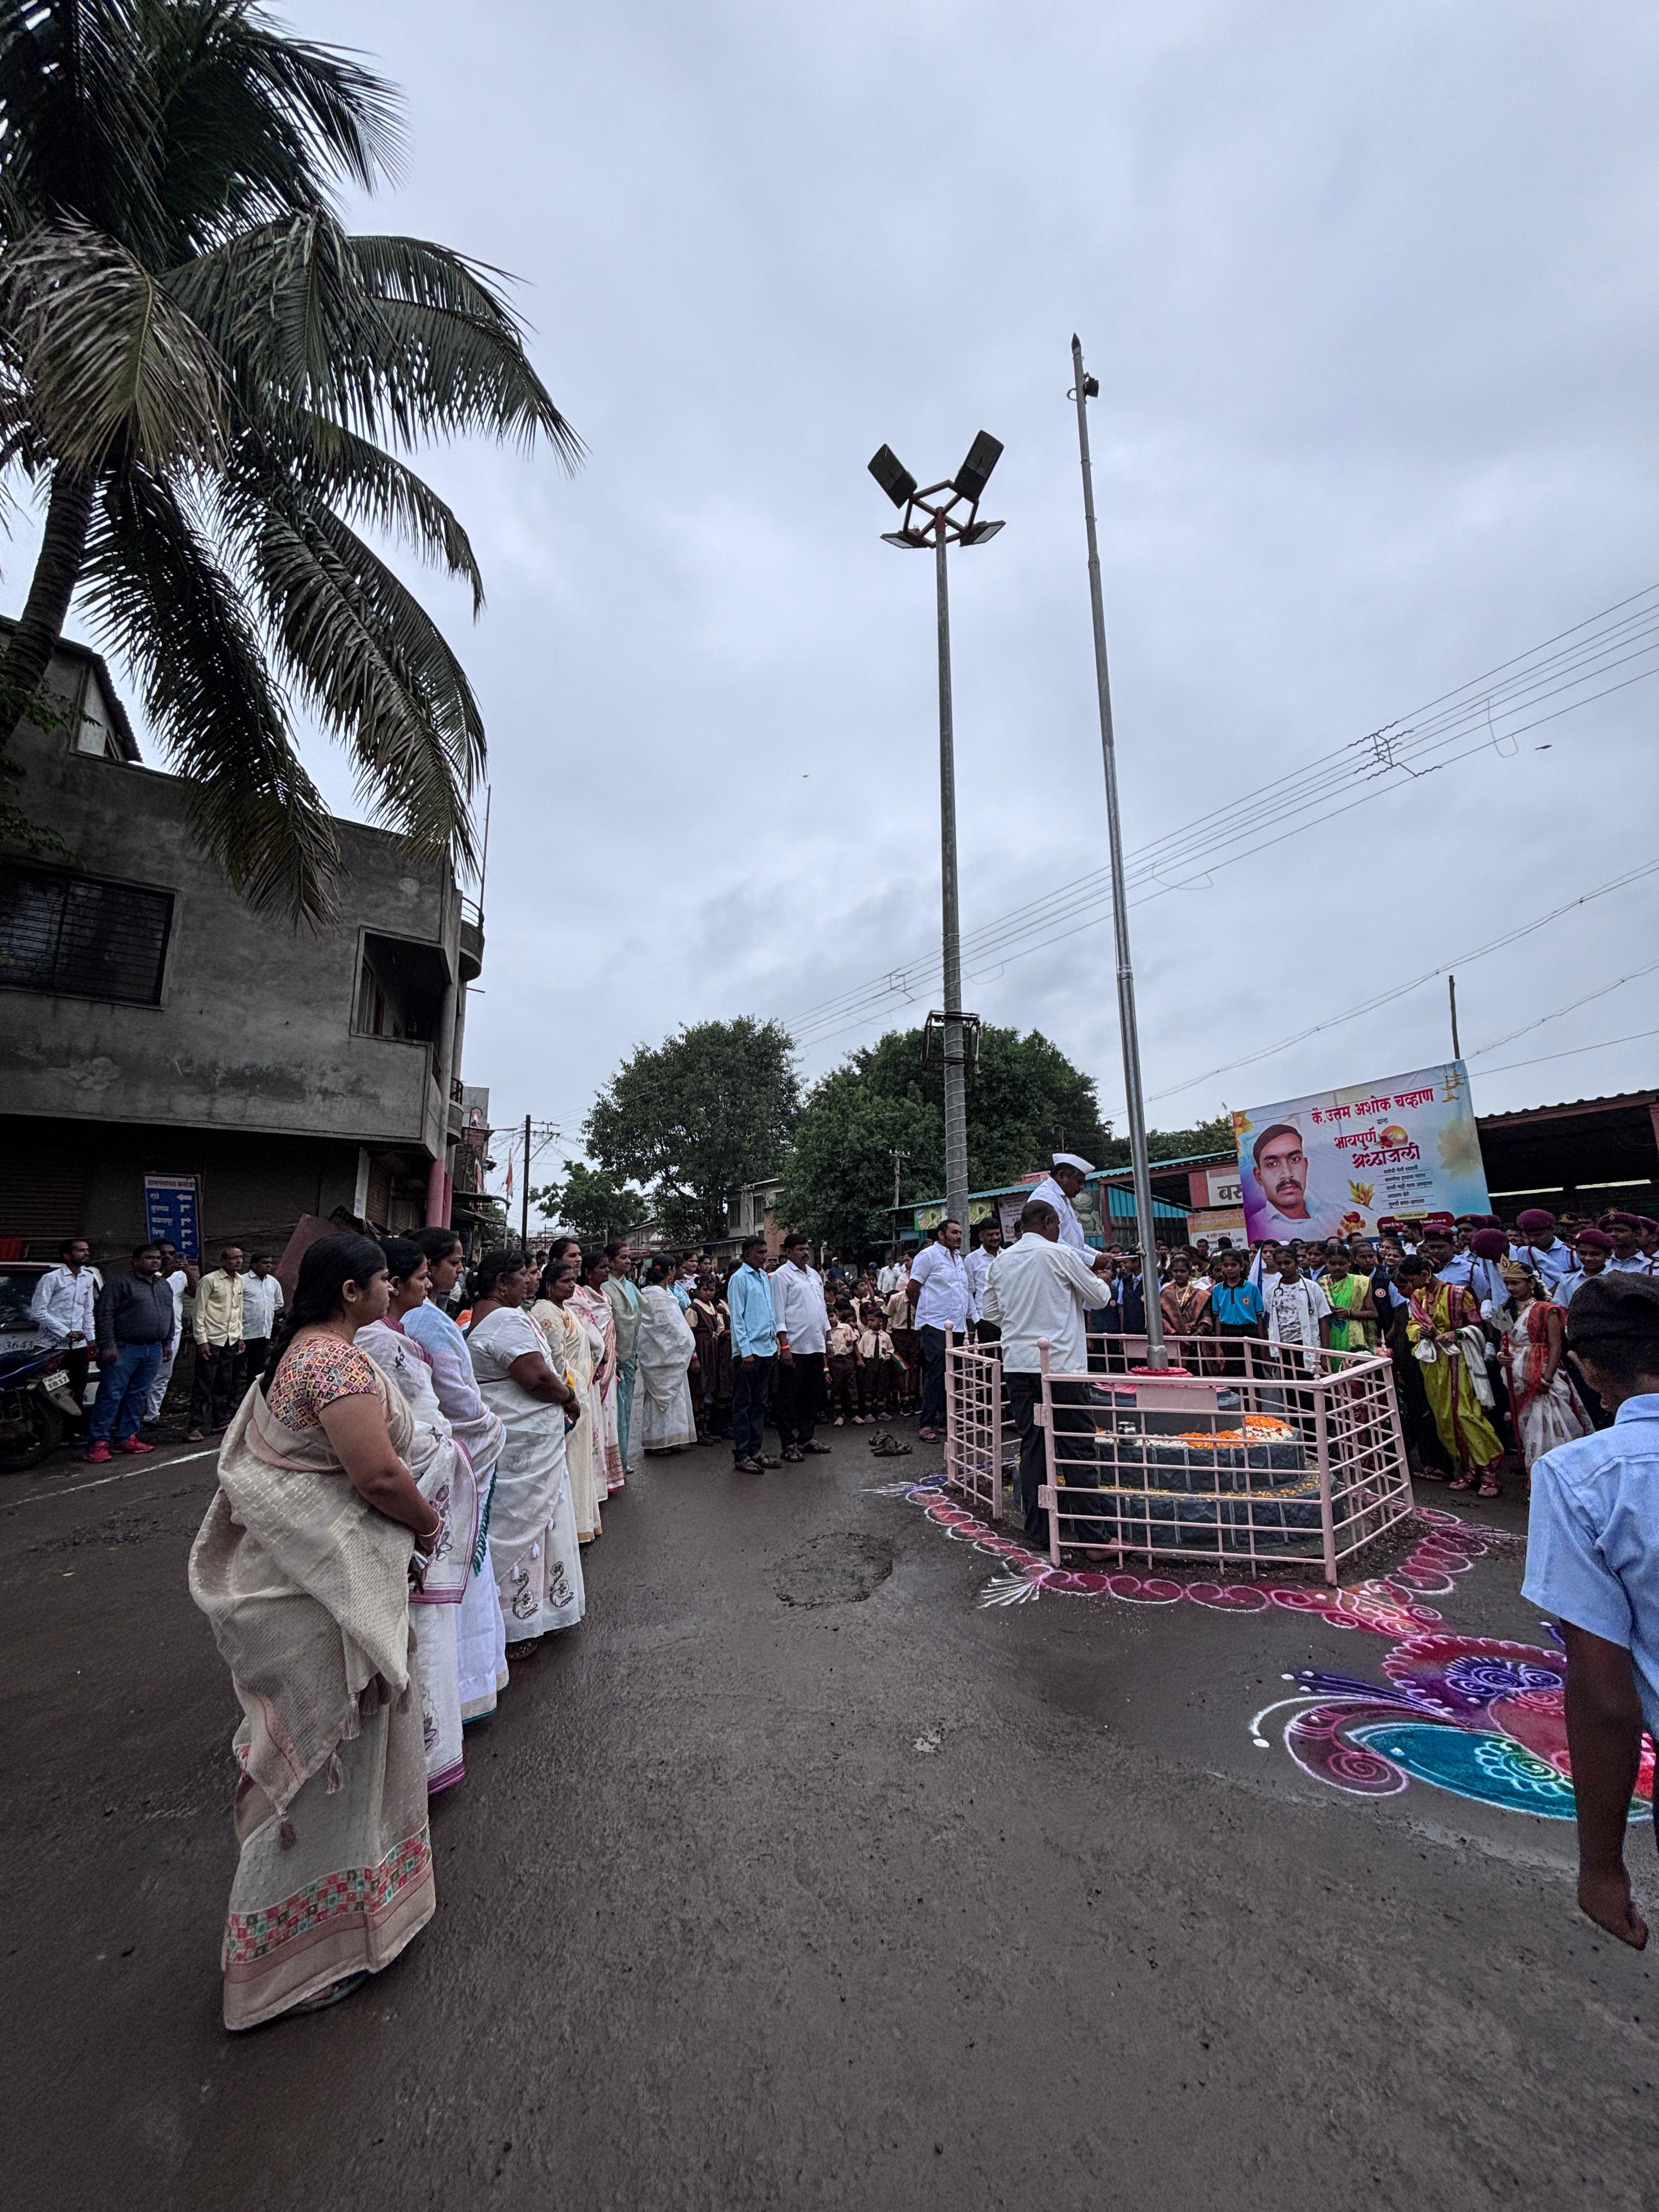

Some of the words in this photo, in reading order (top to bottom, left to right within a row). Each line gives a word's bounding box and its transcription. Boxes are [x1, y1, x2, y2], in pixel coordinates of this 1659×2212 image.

[1355, 1095, 1391, 1115] अशोक
[1393, 1088, 1434, 1109] चव्हाण
[1377, 1116, 1389, 1125] यांना
